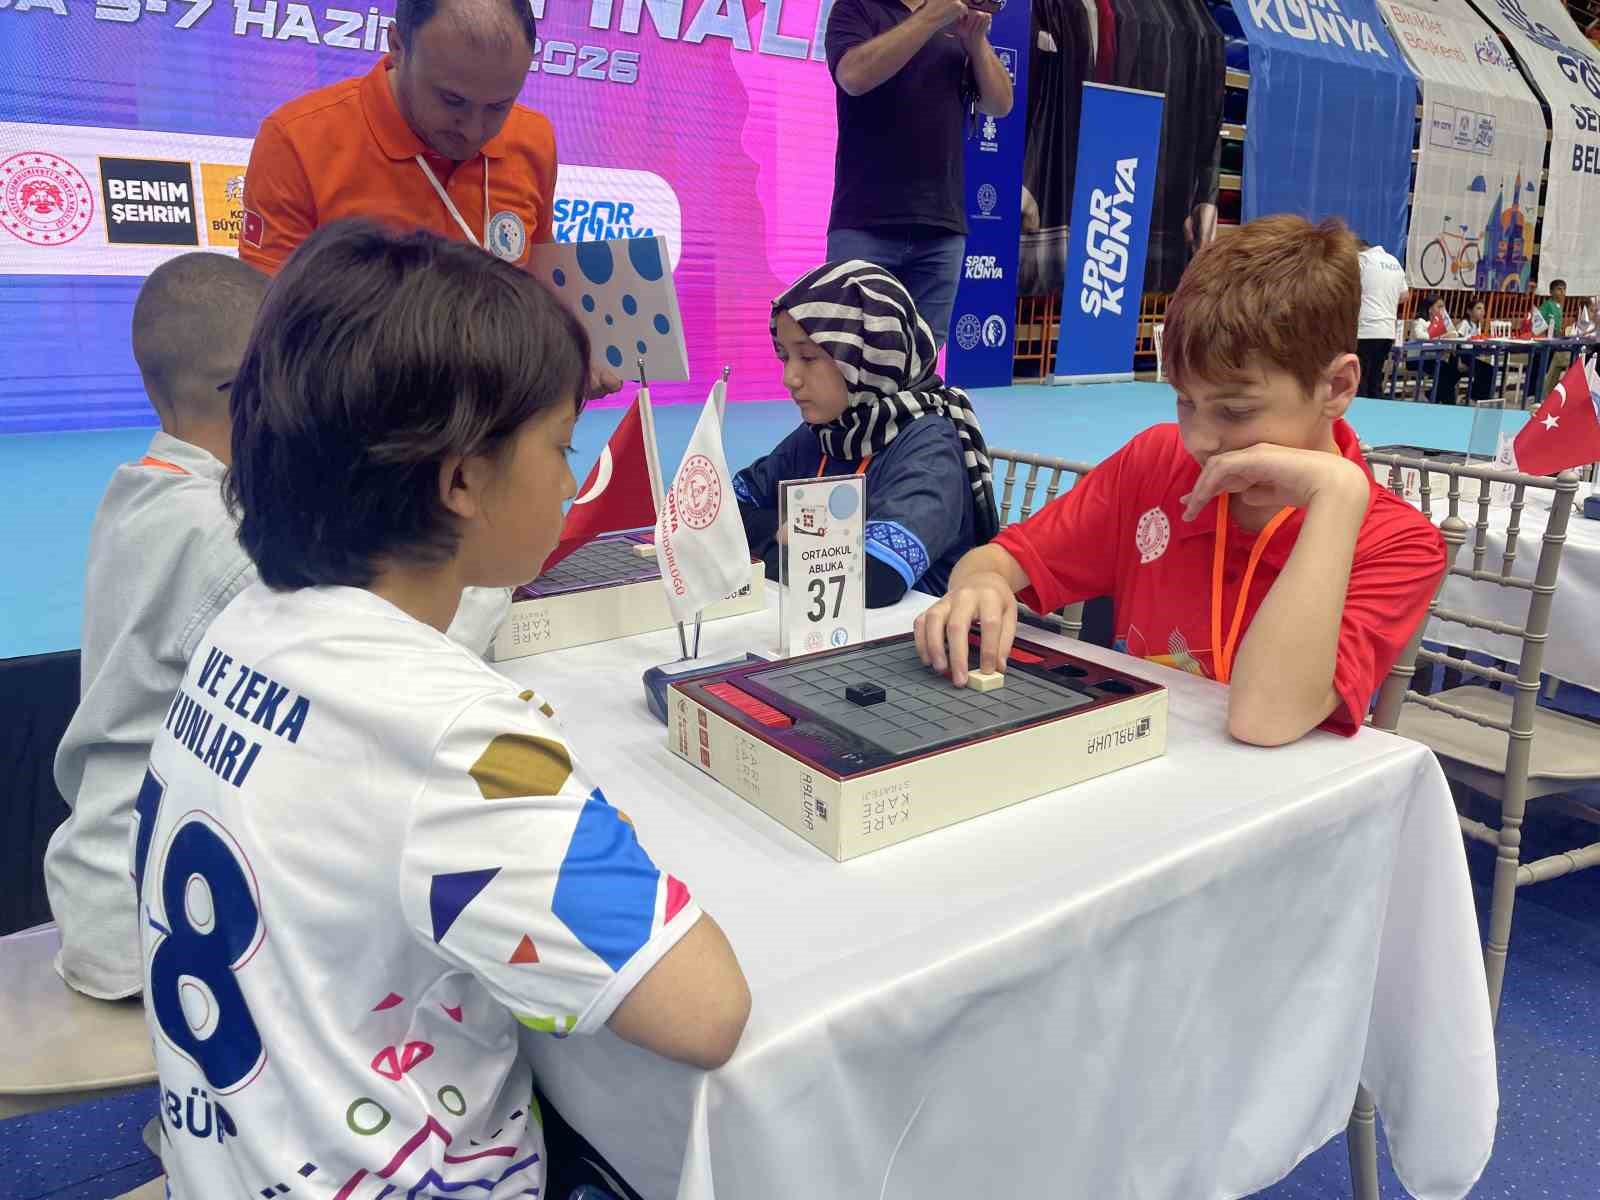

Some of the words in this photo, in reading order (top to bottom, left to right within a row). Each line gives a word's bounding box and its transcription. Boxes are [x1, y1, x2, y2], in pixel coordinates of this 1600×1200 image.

[1249, 0, 1389, 58] KONYA
[553, 198, 635, 228] SPOR
[1081, 187, 1114, 318] SPOR
[1100, 157, 1139, 315] KONYA
[964, 255, 996, 270] SPOR
[964, 265, 1003, 280] KONYA
[801, 545, 852, 561] ORTAOKUL
[808, 560, 844, 575] ABLUKA
[807, 574, 846, 623] 37
[197, 646, 234, 698] VE
[224, 664, 311, 744] ZEKA
